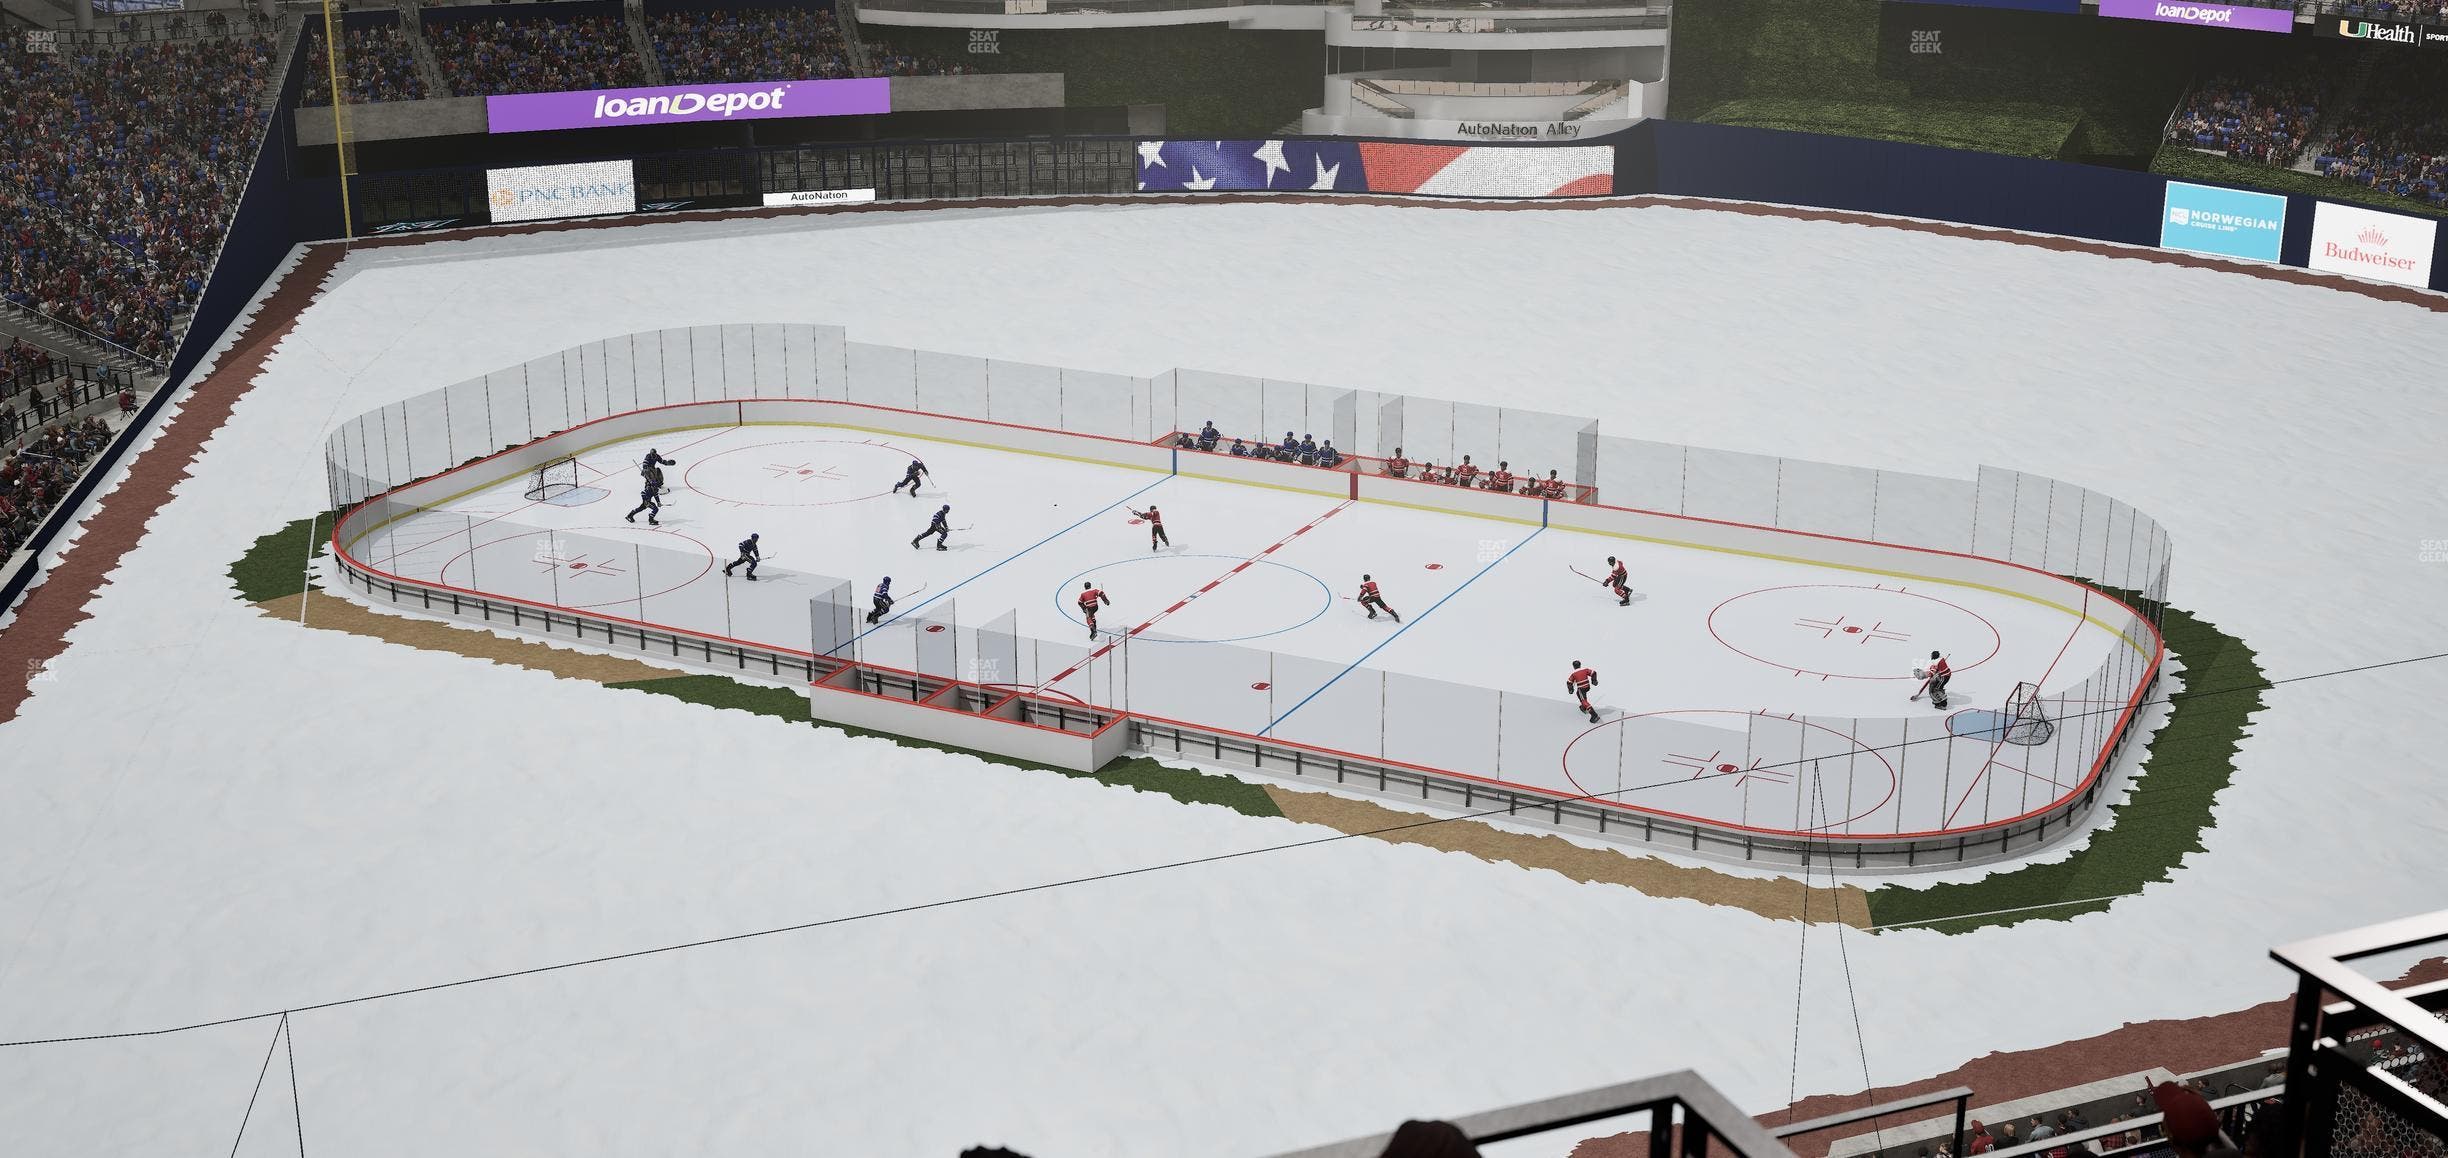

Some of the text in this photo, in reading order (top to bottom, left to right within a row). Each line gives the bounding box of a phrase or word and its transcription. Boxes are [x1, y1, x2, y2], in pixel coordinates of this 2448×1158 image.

[2154, 2, 2232, 23] loanDepot
[2339, 19, 2415, 43] UHealth
[594, 87, 786, 119] loanDepot
[1457, 122, 1581, 138] AutoNation Alley
[519, 182, 631, 203] PNC BANK
[790, 191, 848, 201] AutoNation
[2190, 220, 2216, 230] CRUISE
[2191, 209, 2278, 231] NORWEGIAN
[2325, 241, 2416, 270] Budweiser
